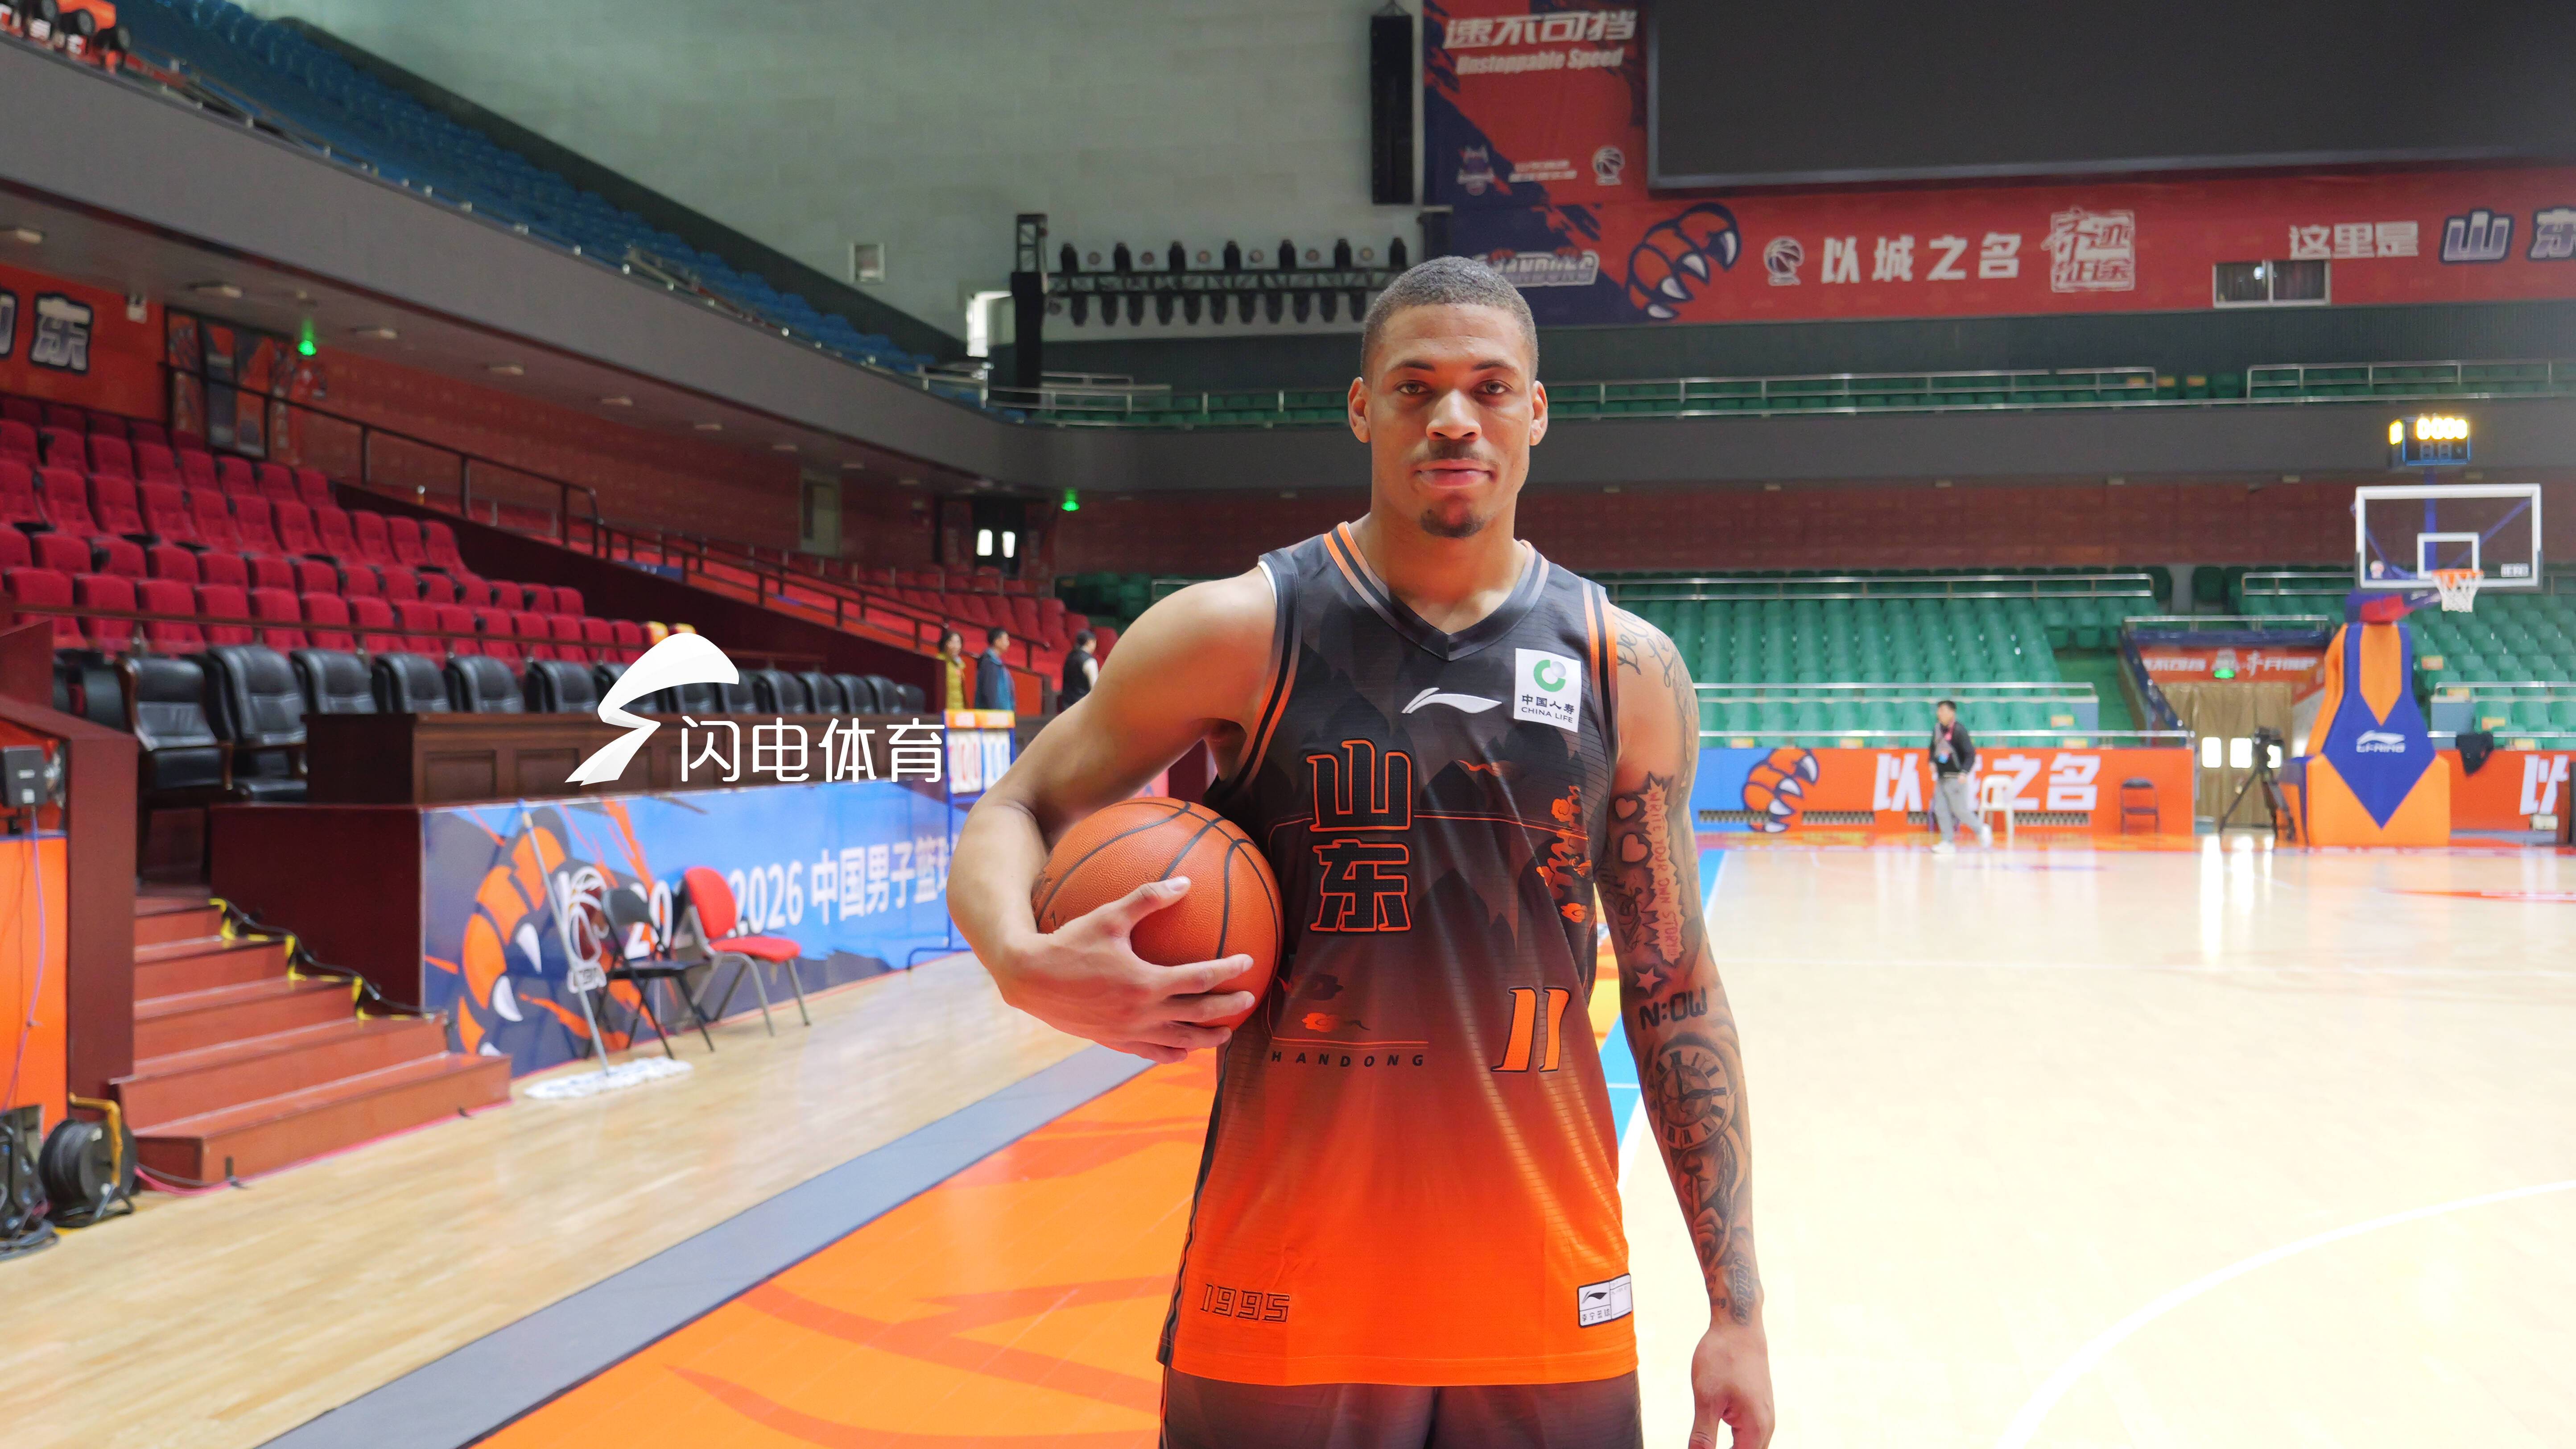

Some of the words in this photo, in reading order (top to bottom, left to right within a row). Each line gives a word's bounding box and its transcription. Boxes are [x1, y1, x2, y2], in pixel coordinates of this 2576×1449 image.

[1443, 9, 1639, 50] 速不可挡
[1456, 51, 1565, 75] Unstoppable
[1566, 47, 1625, 70] Speed
[1821, 231, 2022, 284] 以城之名
[2289, 220, 2419, 261] 这里是
[1521, 707, 1552, 717] CHINA
[1555, 713, 1573, 723] LIFE
[1522, 694, 1575, 715] 中国人寿
[1649, 791, 1665, 832] WRITE
[1306, 739, 1412, 932] 山东
[1653, 838, 1668, 871] YOUR
[1657, 878, 1672, 904] OWN
[1491, 986, 1571, 1072] 11
[1200, 1283, 1290, 1322] 1995
